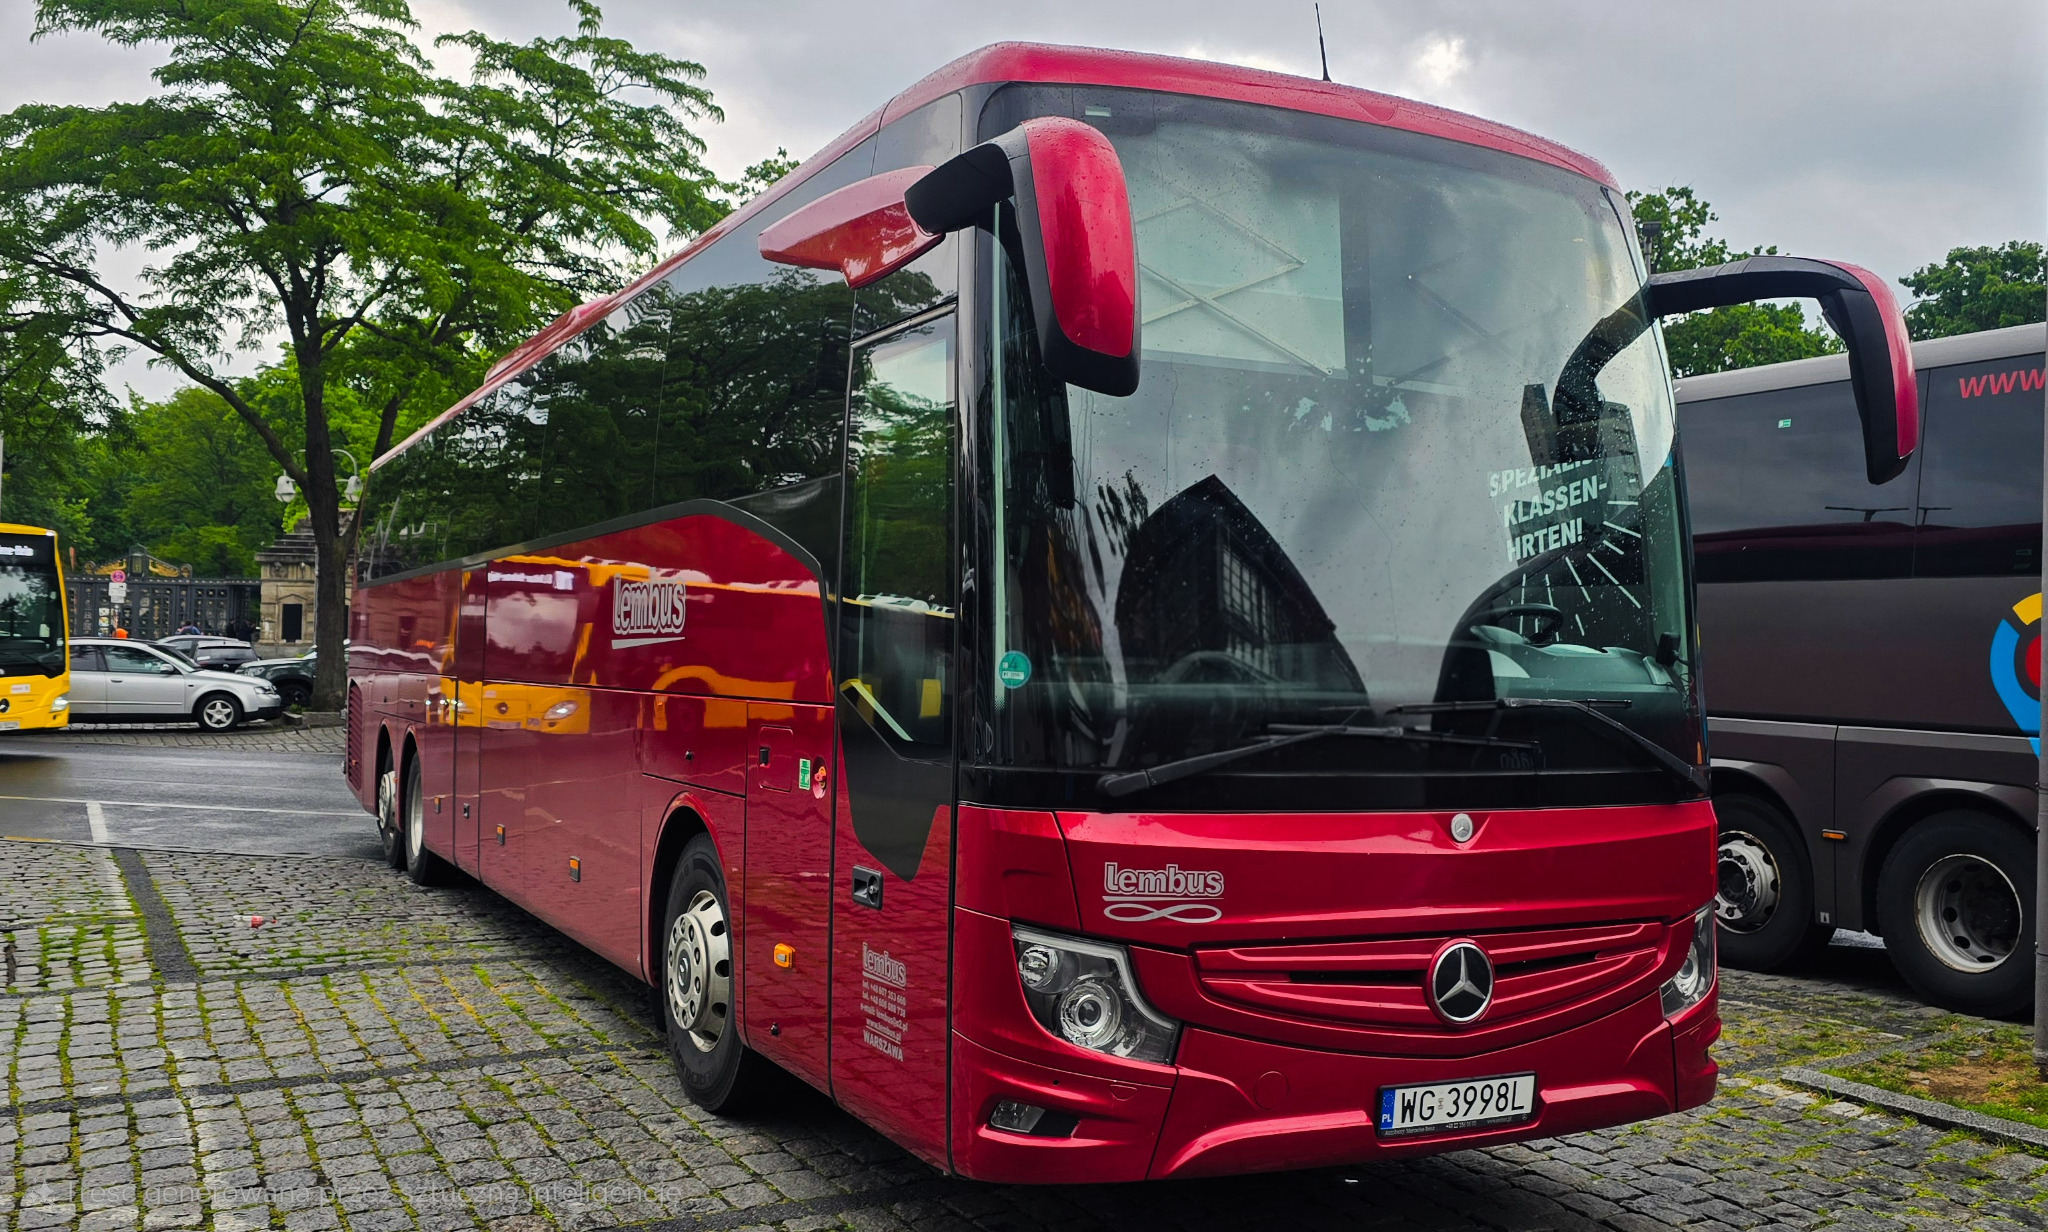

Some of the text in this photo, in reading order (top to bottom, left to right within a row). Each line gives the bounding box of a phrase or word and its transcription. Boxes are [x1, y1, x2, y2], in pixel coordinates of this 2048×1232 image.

[1959, 368, 2046, 398] www
[1504, 475, 1607, 528] KLASSEN-
[613, 567, 687, 635] lembus
[1104, 861, 1225, 896] lembus
[863, 942, 907, 987] lembus
[863, 1029, 904, 1062] WARSZAWA
[1381, 1113, 1392, 1124] PL
[1401, 1080, 1525, 1124] WG 3998L
